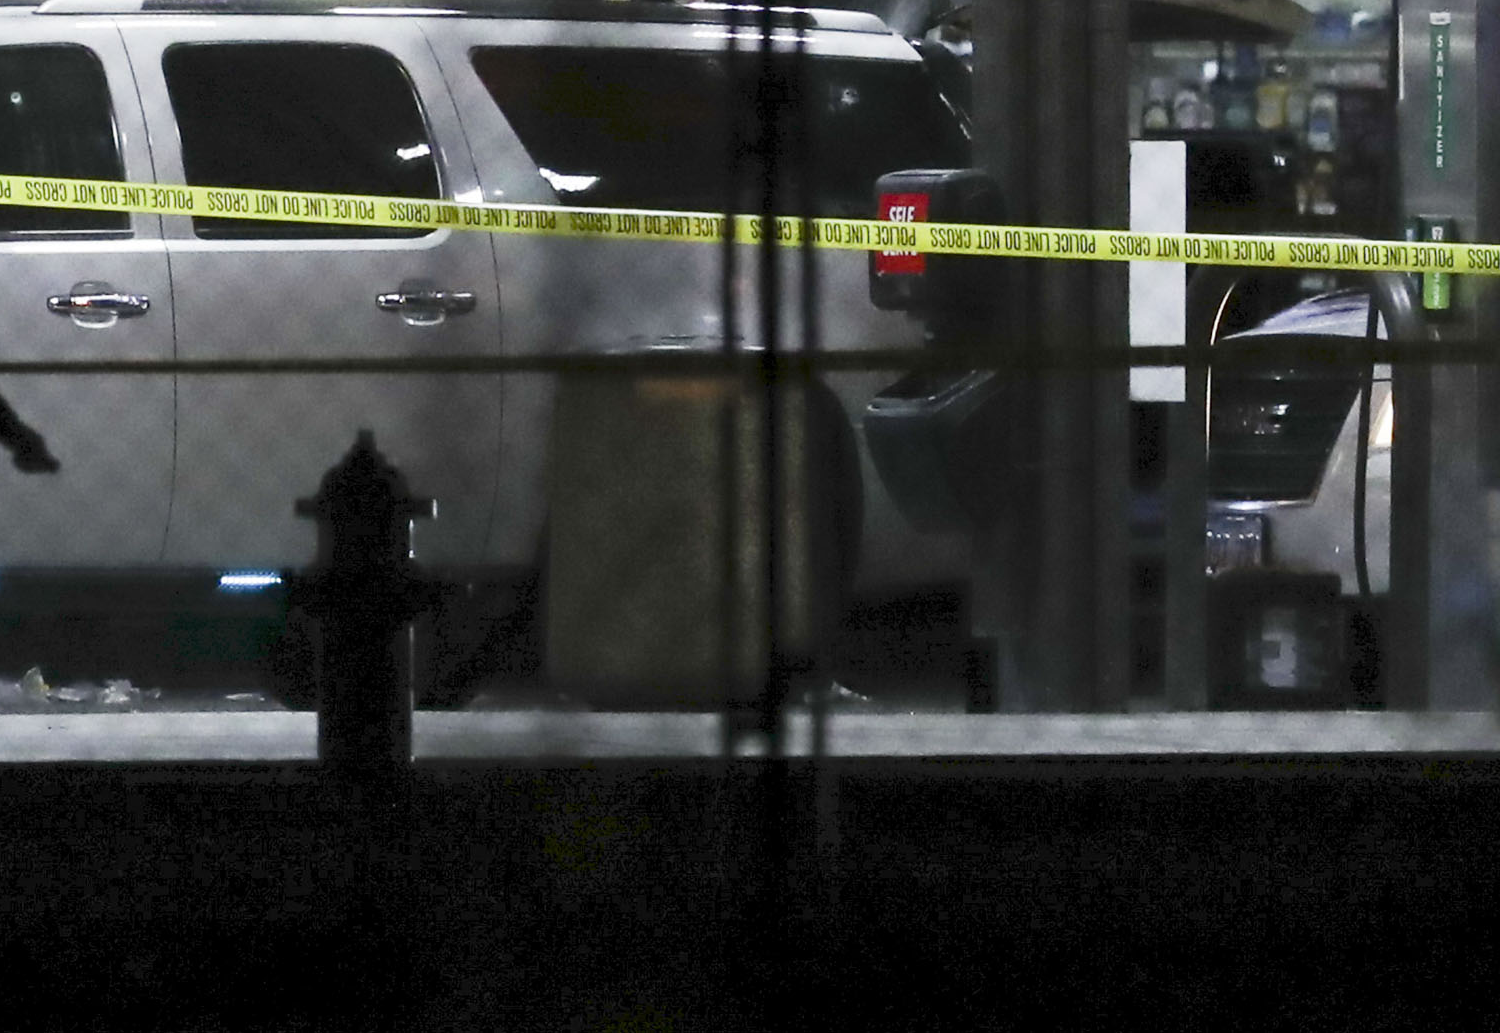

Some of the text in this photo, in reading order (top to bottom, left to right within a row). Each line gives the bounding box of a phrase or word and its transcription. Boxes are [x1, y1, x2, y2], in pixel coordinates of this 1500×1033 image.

[1435, 34, 1444, 168] SANITIZER
[26, 181, 193, 209] POLICE LINE DO NOT CROSS
[208, 191, 374, 220] POLICE LINE DO NOT CROSS
[388, 201, 556, 229] POLICE LINE DO NOT CROSS
[570, 212, 611, 232] CROSS
[617, 214, 640, 233] NOT
[644, 215, 660, 234] DO
[664, 215, 690, 236] LINE
[825, 223, 841, 242] DO
[845, 224, 870, 244] LINE
[874, 225, 916, 246] POLICE
[930, 228, 1096, 253] POLICE LINE DO NOT CROSS
[1110, 235, 1274, 261] POLICE LINE DO NOT CROSS
[1289, 242, 1454, 267] POLICE LINE DO NOT CROSS
